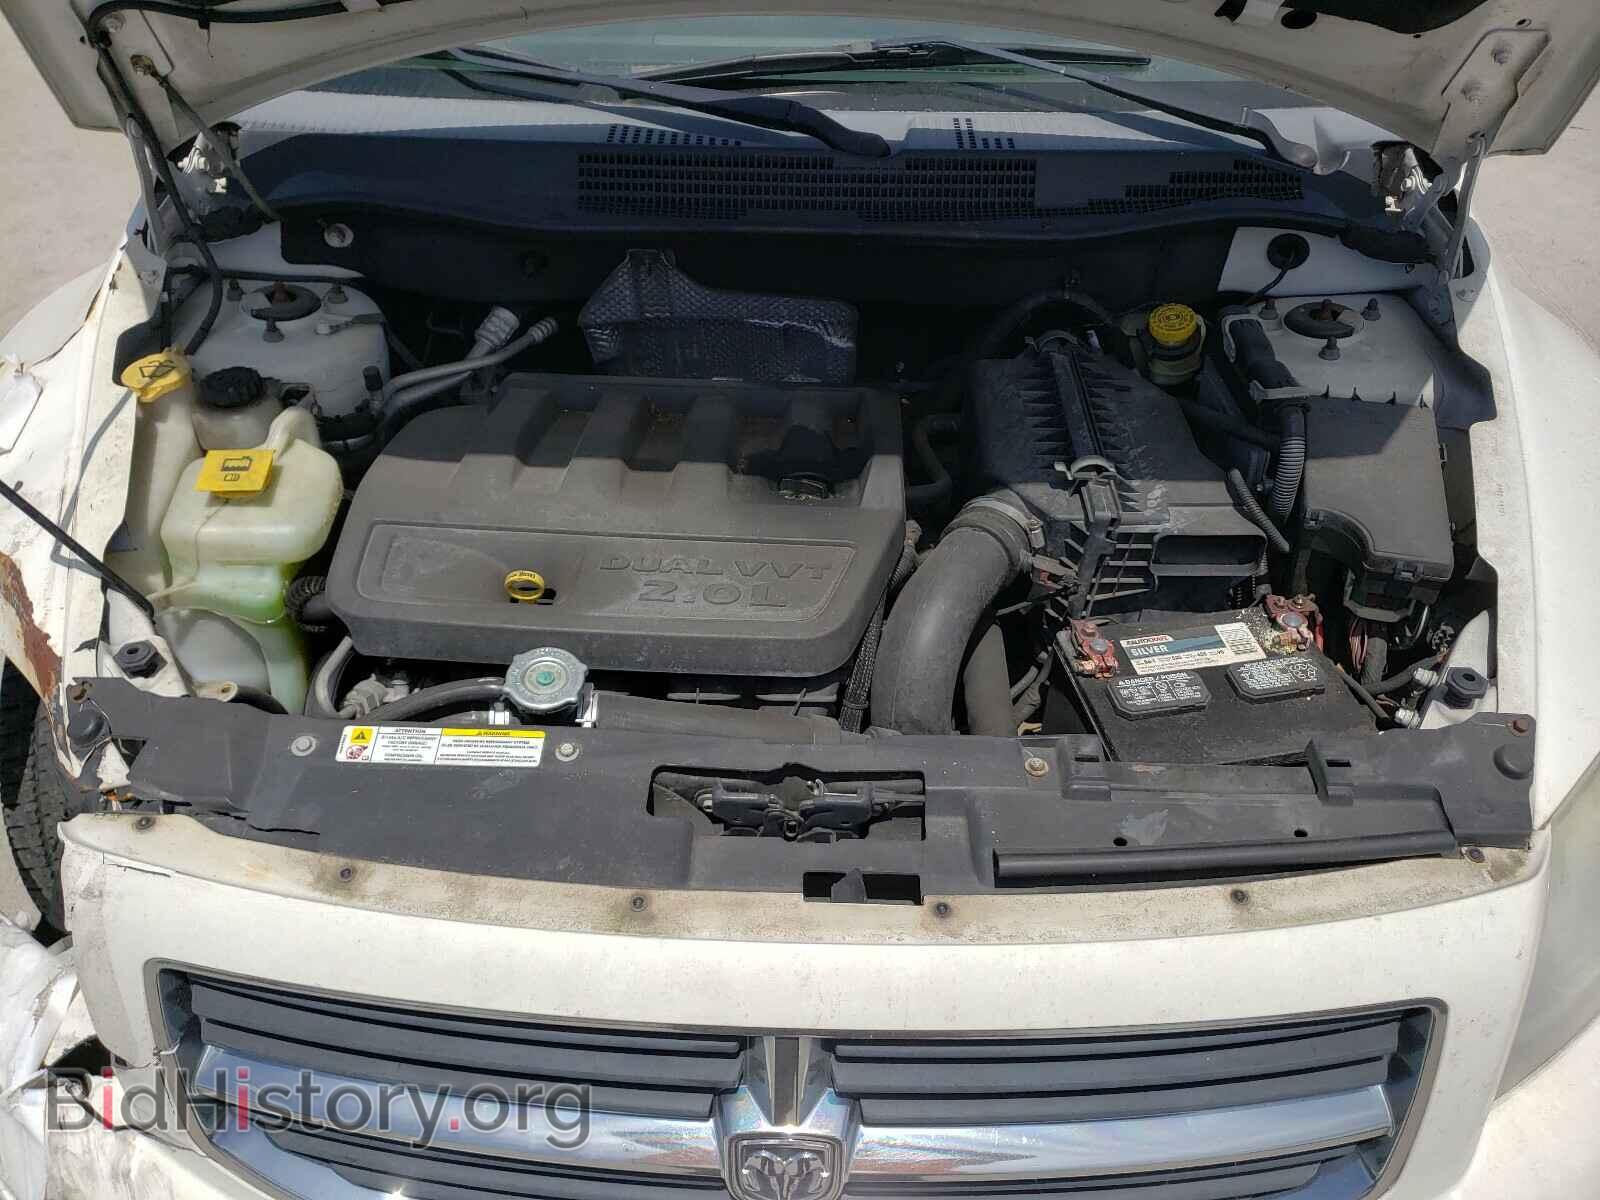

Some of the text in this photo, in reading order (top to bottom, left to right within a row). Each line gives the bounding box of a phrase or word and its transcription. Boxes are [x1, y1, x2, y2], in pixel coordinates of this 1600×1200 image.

[600, 557, 833, 579] DUAL VVT
[638, 579, 787, 607] 2.0L
[1131, 645, 1169, 656] SILVER
